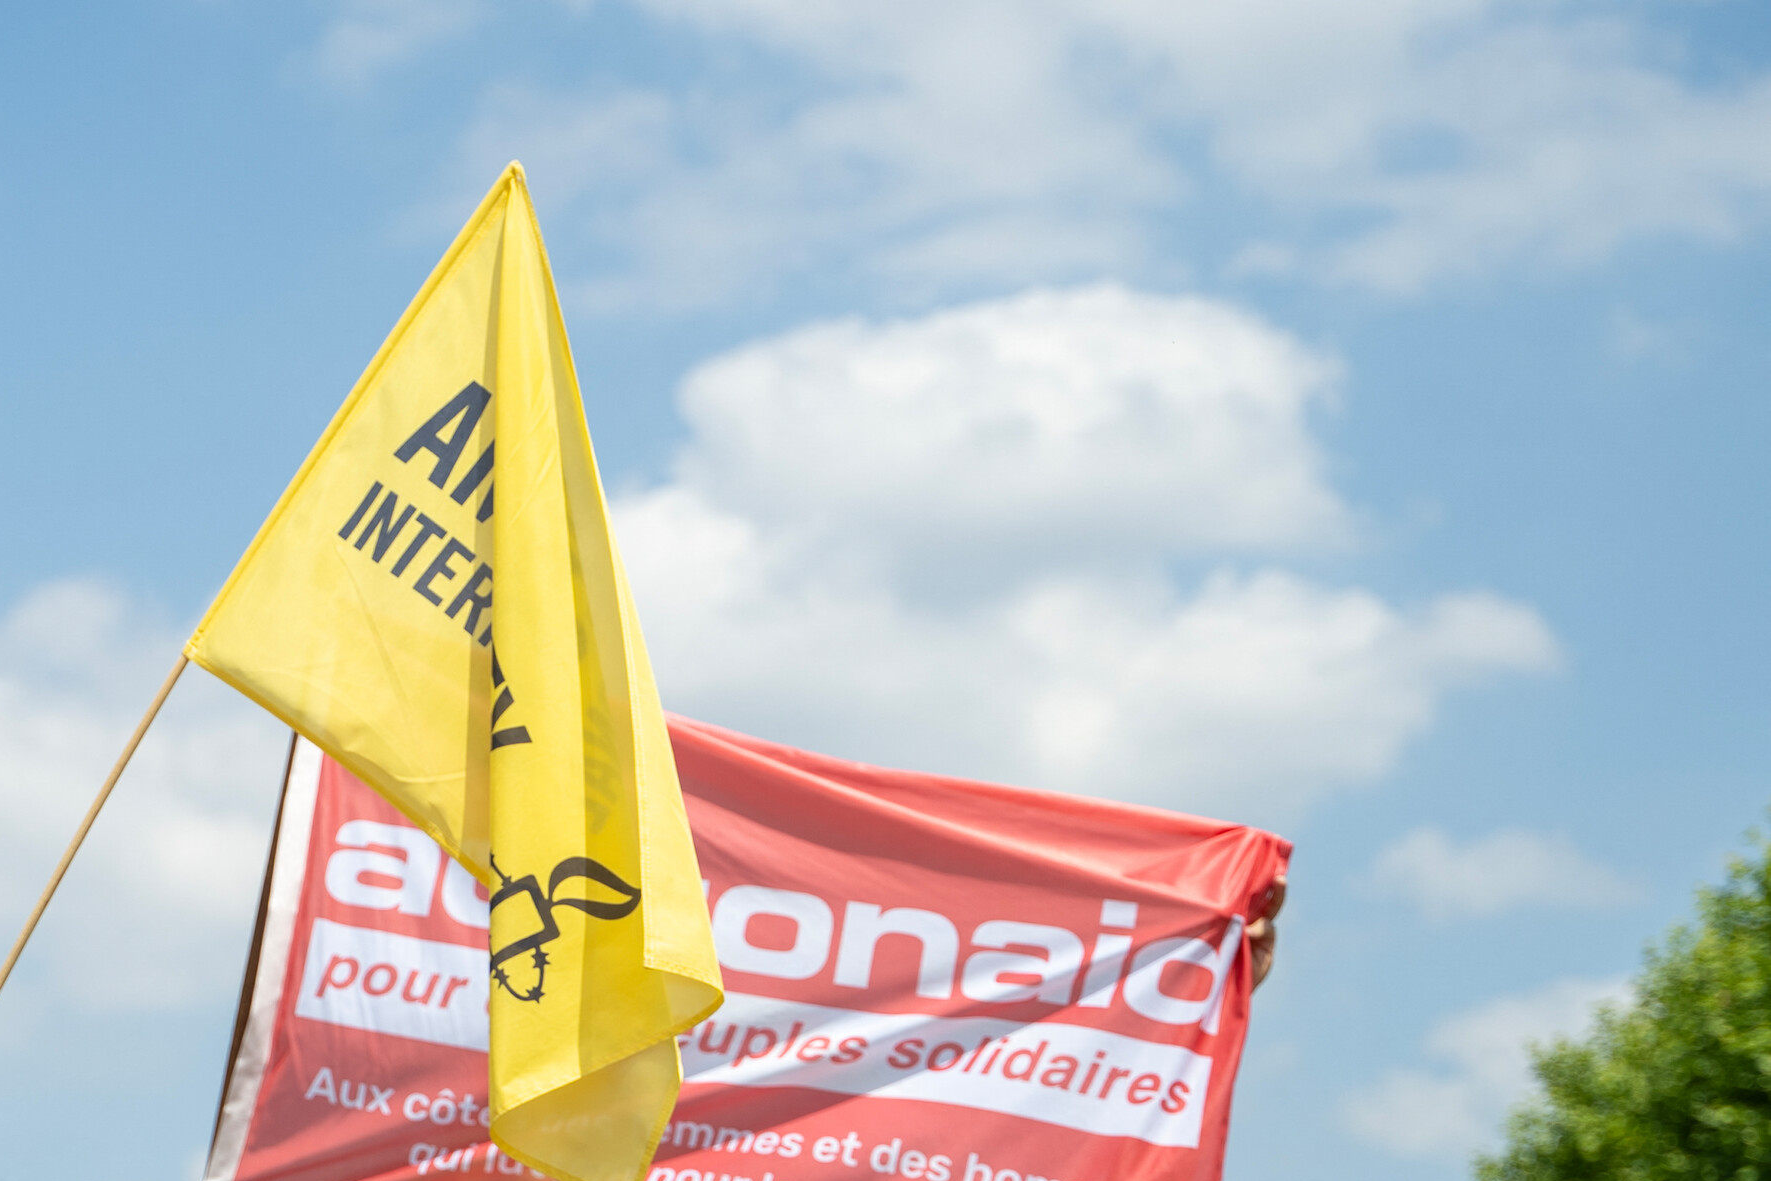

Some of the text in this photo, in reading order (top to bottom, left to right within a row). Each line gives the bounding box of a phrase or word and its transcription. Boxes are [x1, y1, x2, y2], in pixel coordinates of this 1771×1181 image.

[316, 953, 469, 1010] pour
[304, 1066, 490, 1128] Aux côt
[887, 1035, 1193, 1115] solidaires
[408, 1141, 477, 1176] qui
[811, 1130, 864, 1168] et
